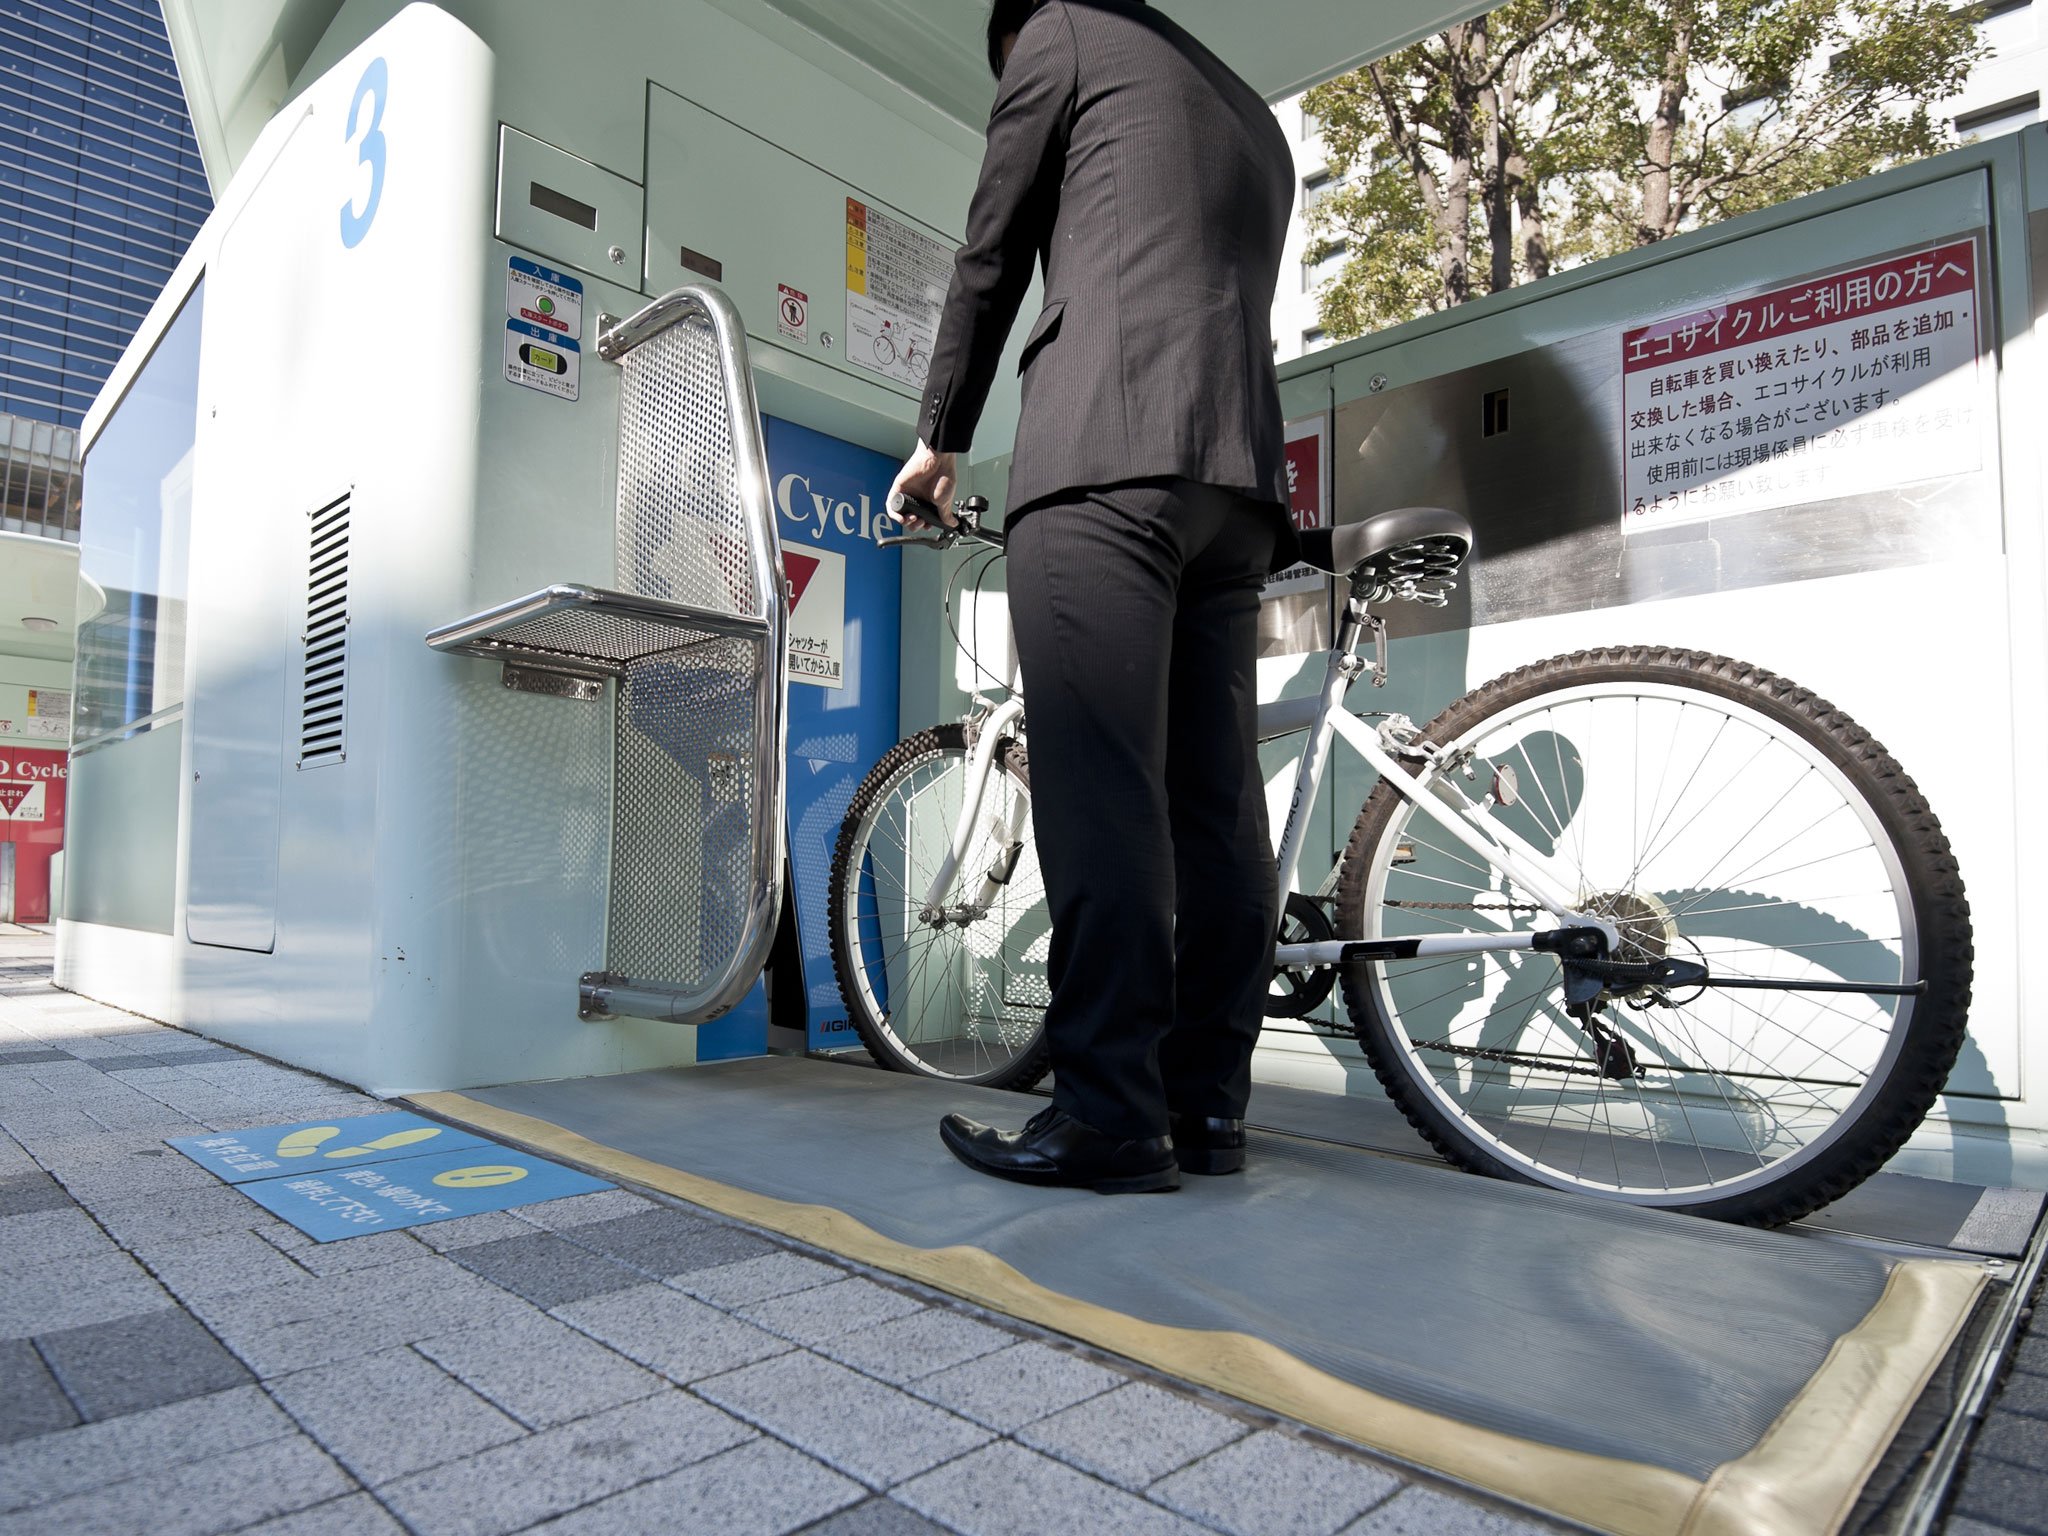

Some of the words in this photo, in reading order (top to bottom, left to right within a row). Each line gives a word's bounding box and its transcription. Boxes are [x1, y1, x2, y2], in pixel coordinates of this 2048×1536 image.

[339, 56, 389, 250] 3
[532, 265, 560, 283] 入庫
[1627, 258, 1967, 364] エコサイクルご利用の方へ
[530, 326, 558, 343] 出庫
[534, 353, 553, 365] カード
[1630, 346, 1931, 431] 交換した場合、エコサイクルが利用
[1631, 387, 1901, 459] 出来なくなる場合がございます。
[777, 472, 893, 541] Cycle
[788, 633, 828, 656] シャッターが
[788, 653, 841, 679] 開いてから入庫
[16, 761, 67, 780] Cycle
[194, 1136, 280, 1174] 操作位置
[283, 1178, 386, 1226] 操作して下さい
[337, 1170, 453, 1216] 黄色い線の外で
